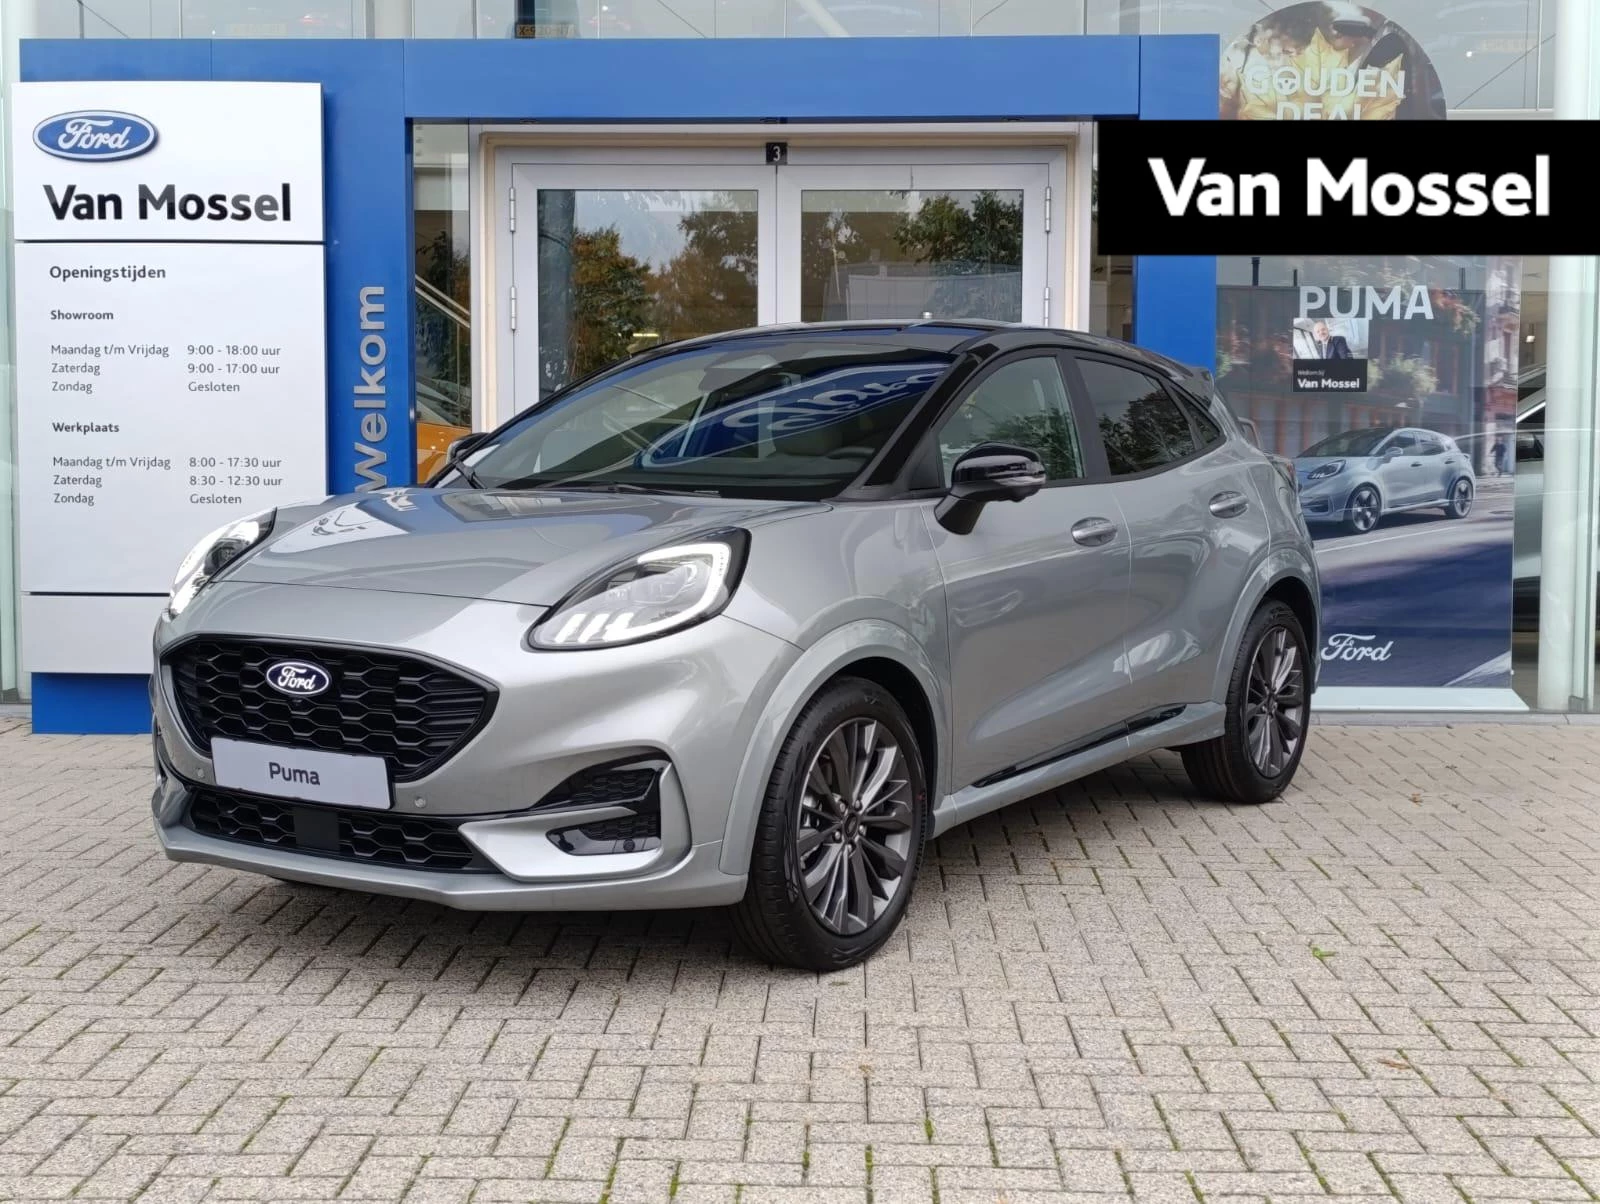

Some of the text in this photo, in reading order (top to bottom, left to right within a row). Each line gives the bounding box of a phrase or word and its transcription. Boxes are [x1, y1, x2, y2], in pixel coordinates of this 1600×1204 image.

[1246, 66, 1406, 99] GOUDEN
[58, 118, 132, 150] Ford
[773, 145, 781, 162] 3
[43, 183, 291, 221] Van Mossel
[49, 265, 166, 282] Openingstijden
[1299, 285, 1434, 320] PUMA
[50, 309, 114, 321] Showroom
[51, 343, 101, 357] Maandag
[103, 343, 126, 355] t/m
[128, 343, 169, 358] Vrijdag
[187, 344, 214, 356] 9:00
[226, 344, 258, 356] 18:00
[261, 347, 281, 356] uur
[51, 362, 101, 376] Zaterdag
[187, 363, 214, 374] 9:00
[226, 363, 258, 374] 17:00
[261, 365, 281, 374] uur
[52, 381, 241, 394] Zondag Gesloten
[354, 286, 388, 493] Welkom
[1297, 377, 1360, 389] Van Mossel
[51, 421, 120, 435] Werkplaats
[53, 455, 103, 470] Maandag
[106, 455, 127, 467] t/m
[129, 455, 171, 471] Vrijdag
[189, 456, 216, 468] 8:00
[228, 457, 259, 468] 17:30
[262, 459, 282, 468] uur
[53, 474, 102, 489] Zaterdag
[189, 475, 216, 486] 8:30
[228, 475, 261, 486] 12:30
[263, 478, 284, 486] uur
[53, 493, 242, 507] Zondag Gesloten
[1320, 633, 1394, 661] Ford
[278, 666, 316, 690] Ford
[268, 761, 321, 786] Puma
